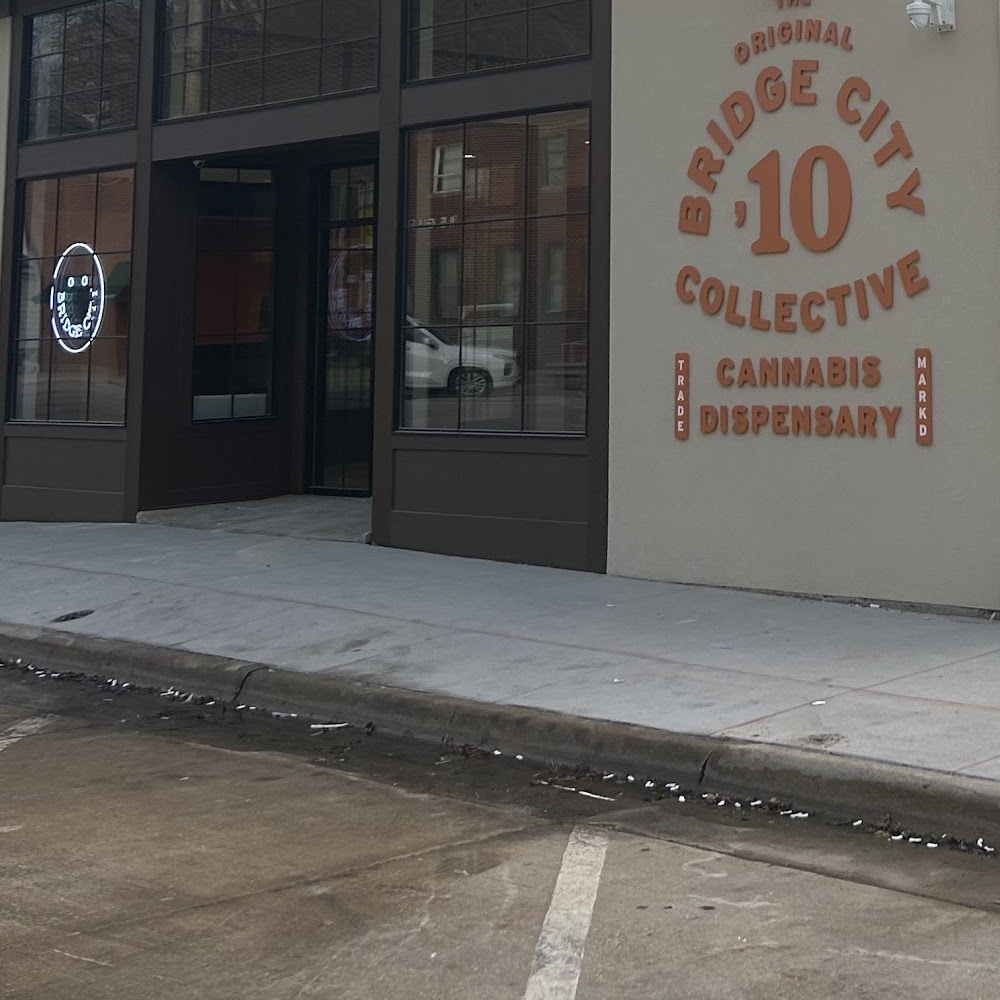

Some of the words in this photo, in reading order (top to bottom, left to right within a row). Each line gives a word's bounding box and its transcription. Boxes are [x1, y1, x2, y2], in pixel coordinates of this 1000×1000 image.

[734, 19, 853, 64] ORIGINAL
[678, 59, 819, 236] BRIDGE
[836, 76, 926, 216] CITY
[675, 249, 930, 333] COLLECTIVE
[676, 359, 685, 432] TRADE
[716, 356, 882, 388] CANNABIS
[917, 356, 928, 437] MARKD
[700, 404, 902, 438] DISPENSARY
